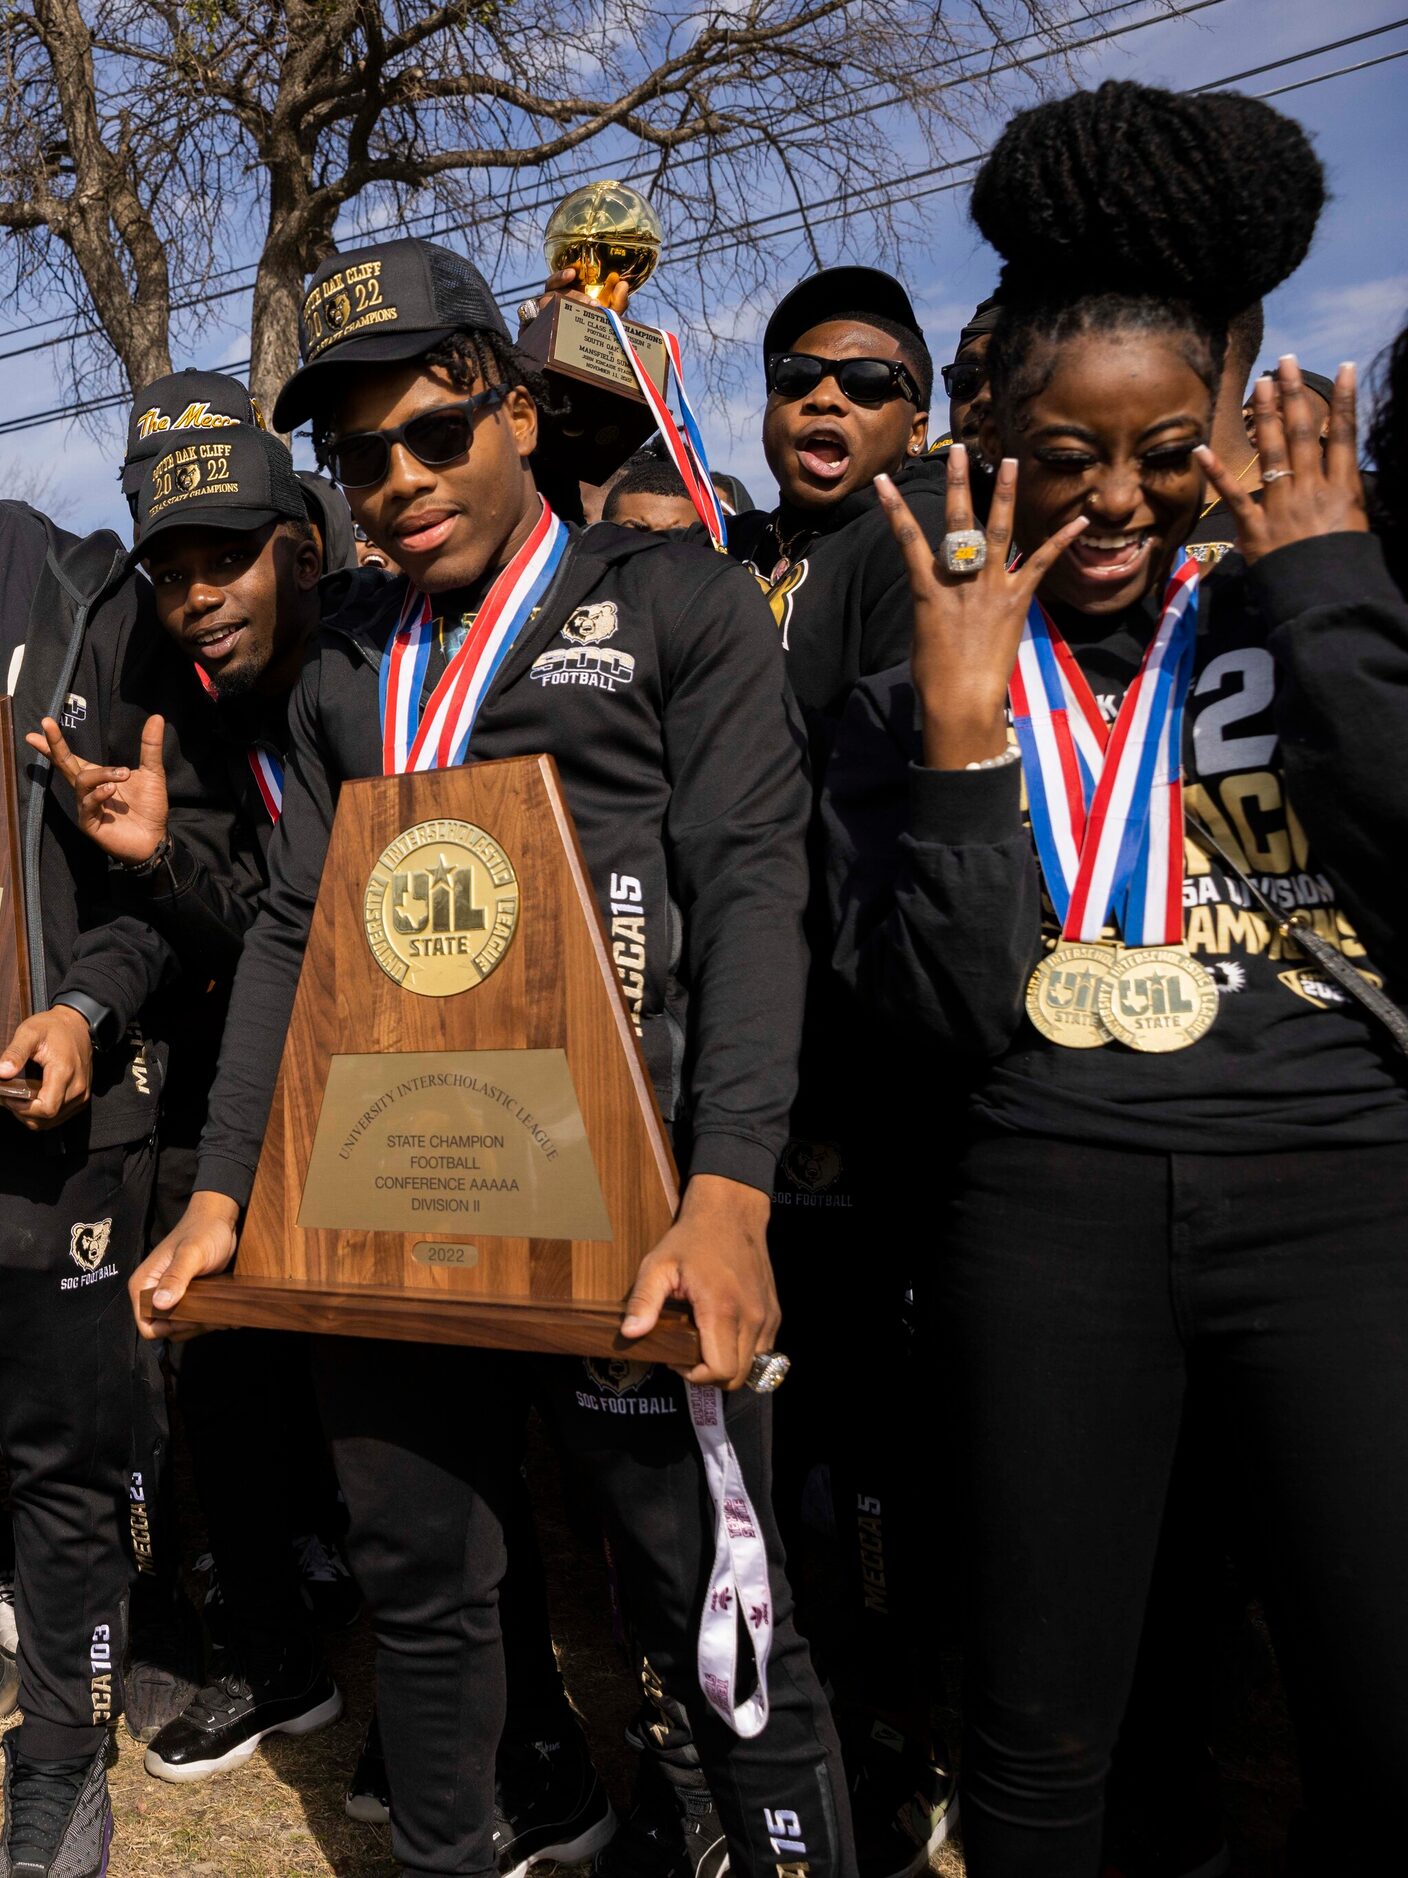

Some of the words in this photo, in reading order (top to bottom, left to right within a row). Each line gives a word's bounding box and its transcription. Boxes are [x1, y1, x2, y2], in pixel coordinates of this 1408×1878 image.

[346, 261, 382, 285] CLIFF
[355, 279, 383, 313] 22
[343, 307, 398, 336] CHAMPIONS
[583, 310, 611, 325] DISTRI
[623, 325, 663, 345] HAMPIONS
[584, 335, 604, 348] SOUTH
[137, 407, 171, 440] The
[199, 444, 232, 458] CLIFF
[154, 473, 172, 501] 20
[206, 458, 229, 481] 22
[189, 482, 239, 498] CHAMPIONS
[542, 671, 616, 692] FOOTBALL
[393, 868, 487, 935] UIL
[366, 877, 410, 985] UNIVERSITY
[473, 899, 516, 977] LEAGUE
[409, 935, 469, 957] STATE
[1118, 974, 1193, 1017] UIL
[1135, 1015, 1181, 1030] STATE
[338, 1089, 396, 1162] UNIVERSITY
[396, 1072, 515, 1110] INTERSCHOLASTIC
[514, 1103, 560, 1163] LEAGUE
[387, 1134, 427, 1150] STATE
[429, 1134, 505, 1150] CHAMPION
[410, 1155, 481, 1171] FOOTBALL
[374, 1176, 467, 1192] CONFERENCE
[469, 1178, 520, 1192] AAAAA
[411, 1197, 471, 1212] DIVISION
[473, 1199, 481, 1213] II
[427, 1247, 465, 1263] 2022
[61, 1276, 81, 1291] SOC
[81, 1264, 119, 1289] FOOTBALL
[599, 1396, 678, 1415] FOOTBALL
